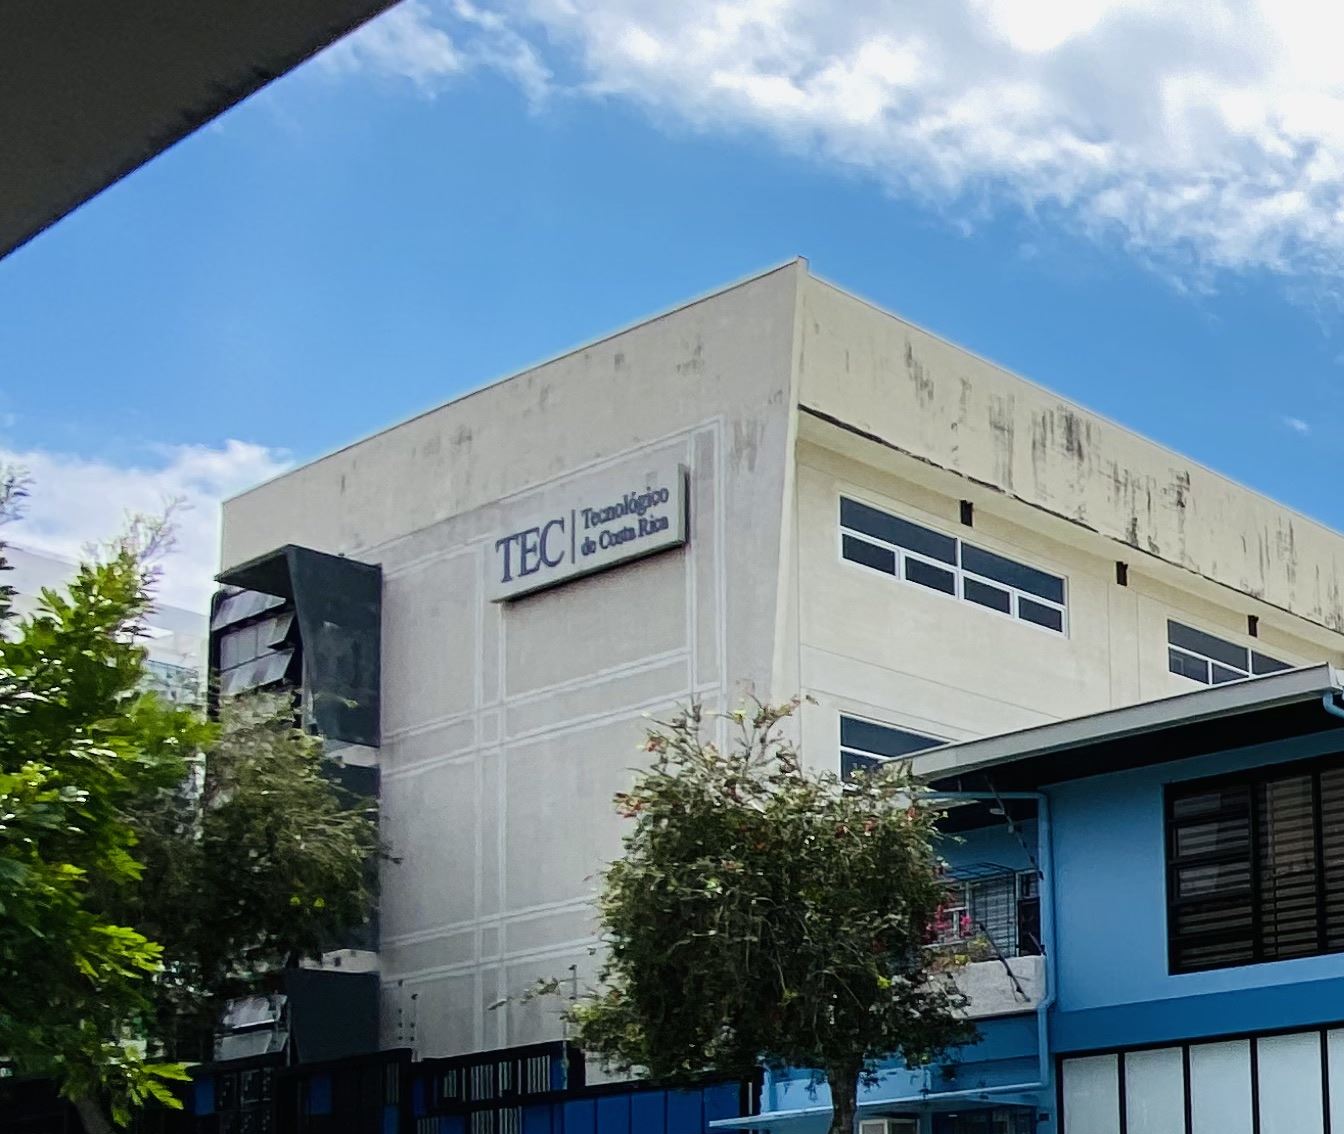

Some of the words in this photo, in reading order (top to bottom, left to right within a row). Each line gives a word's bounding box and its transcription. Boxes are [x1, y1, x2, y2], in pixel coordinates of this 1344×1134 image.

[581, 486, 669, 529] Tecnológico
[495, 517, 565, 584] TEC
[581, 536, 596, 557] de
[599, 526, 637, 550] Costa
[638, 514, 669, 538] Rica
